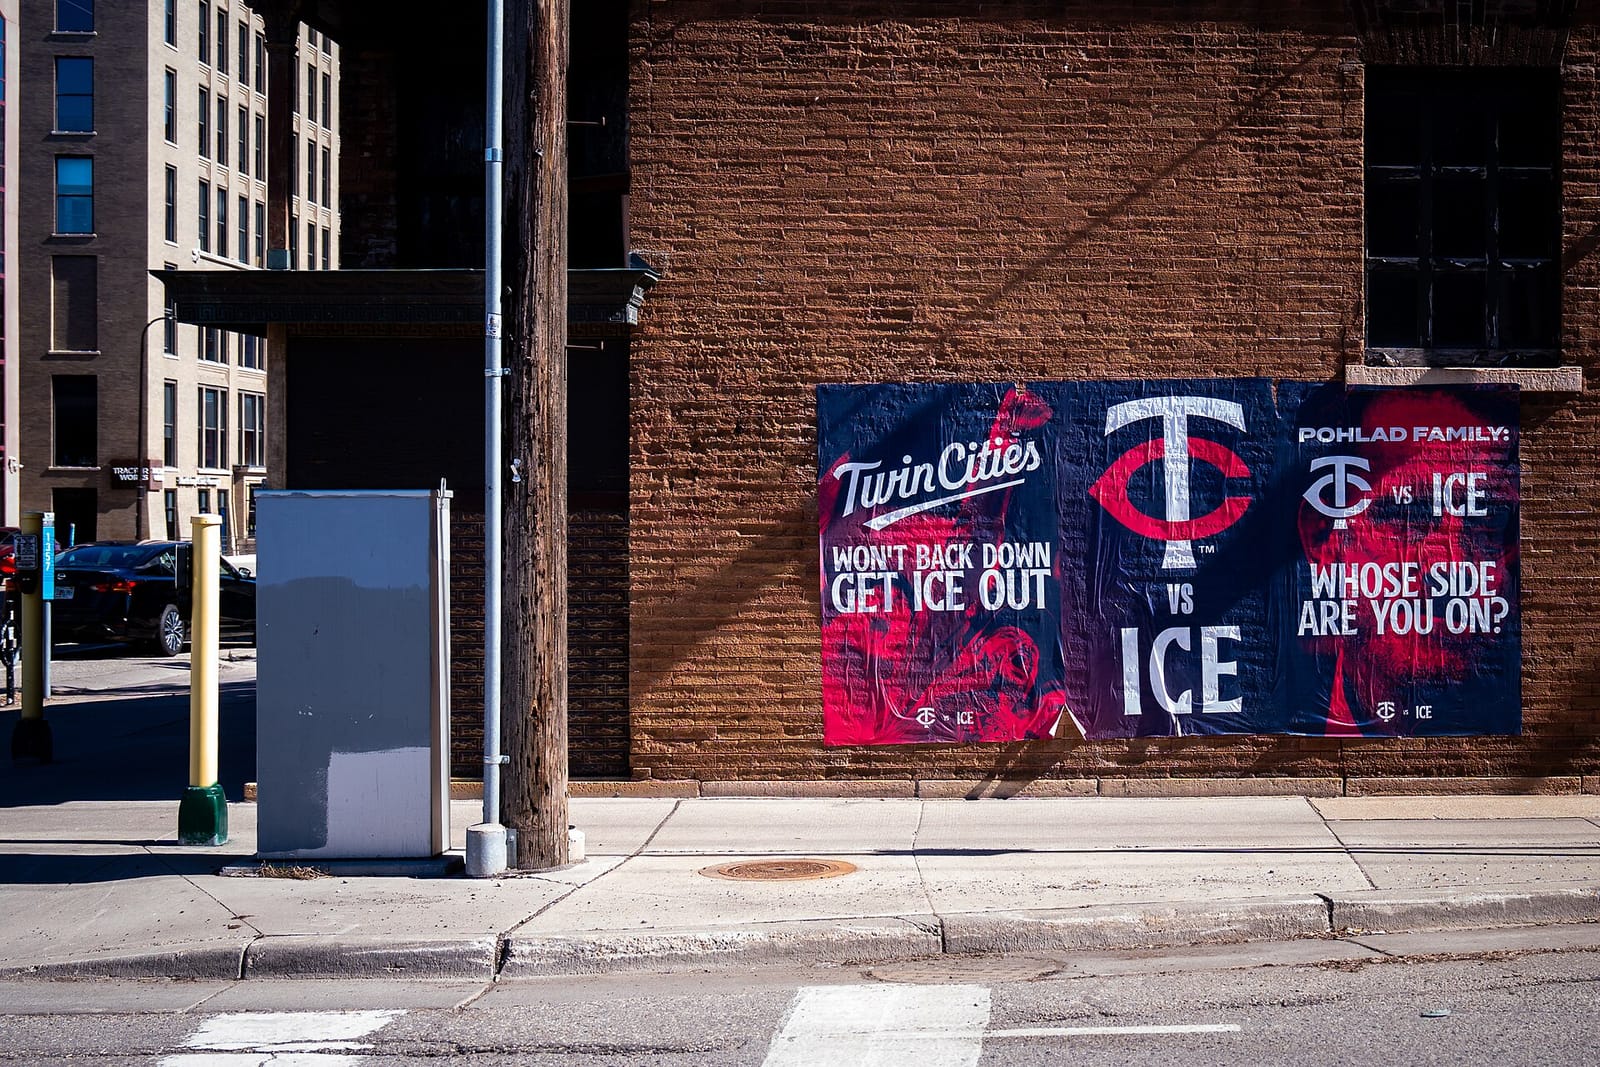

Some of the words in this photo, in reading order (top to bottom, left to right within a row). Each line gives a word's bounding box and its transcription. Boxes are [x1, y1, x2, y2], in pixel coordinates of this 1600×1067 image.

[1298, 426, 1407, 443] POHLAD
[1413, 425, 1510, 443] FAMILY:
[833, 453, 936, 517] Twin
[936, 436, 1041, 490] Cities
[1432, 472, 1488, 517] ICE
[832, 544, 909, 572] WON'T
[916, 543, 975, 571] BACK
[982, 541, 1051, 569] DOWN
[831, 572, 899, 613] GET
[912, 571, 965, 612] ICE
[978, 568, 1052, 611] OUT
[1166, 583, 1194, 615] VS
[1310, 562, 1419, 599] WHOSE
[1430, 560, 1497, 597] SIDE
[1297, 600, 1358, 637] ARE
[1371, 598, 1434, 635] YOU
[1445, 595, 1509, 634] ON?
[1120, 625, 1243, 716] ICE
[956, 711, 974, 724] ICE
[1415, 705, 1432, 719] ICE
